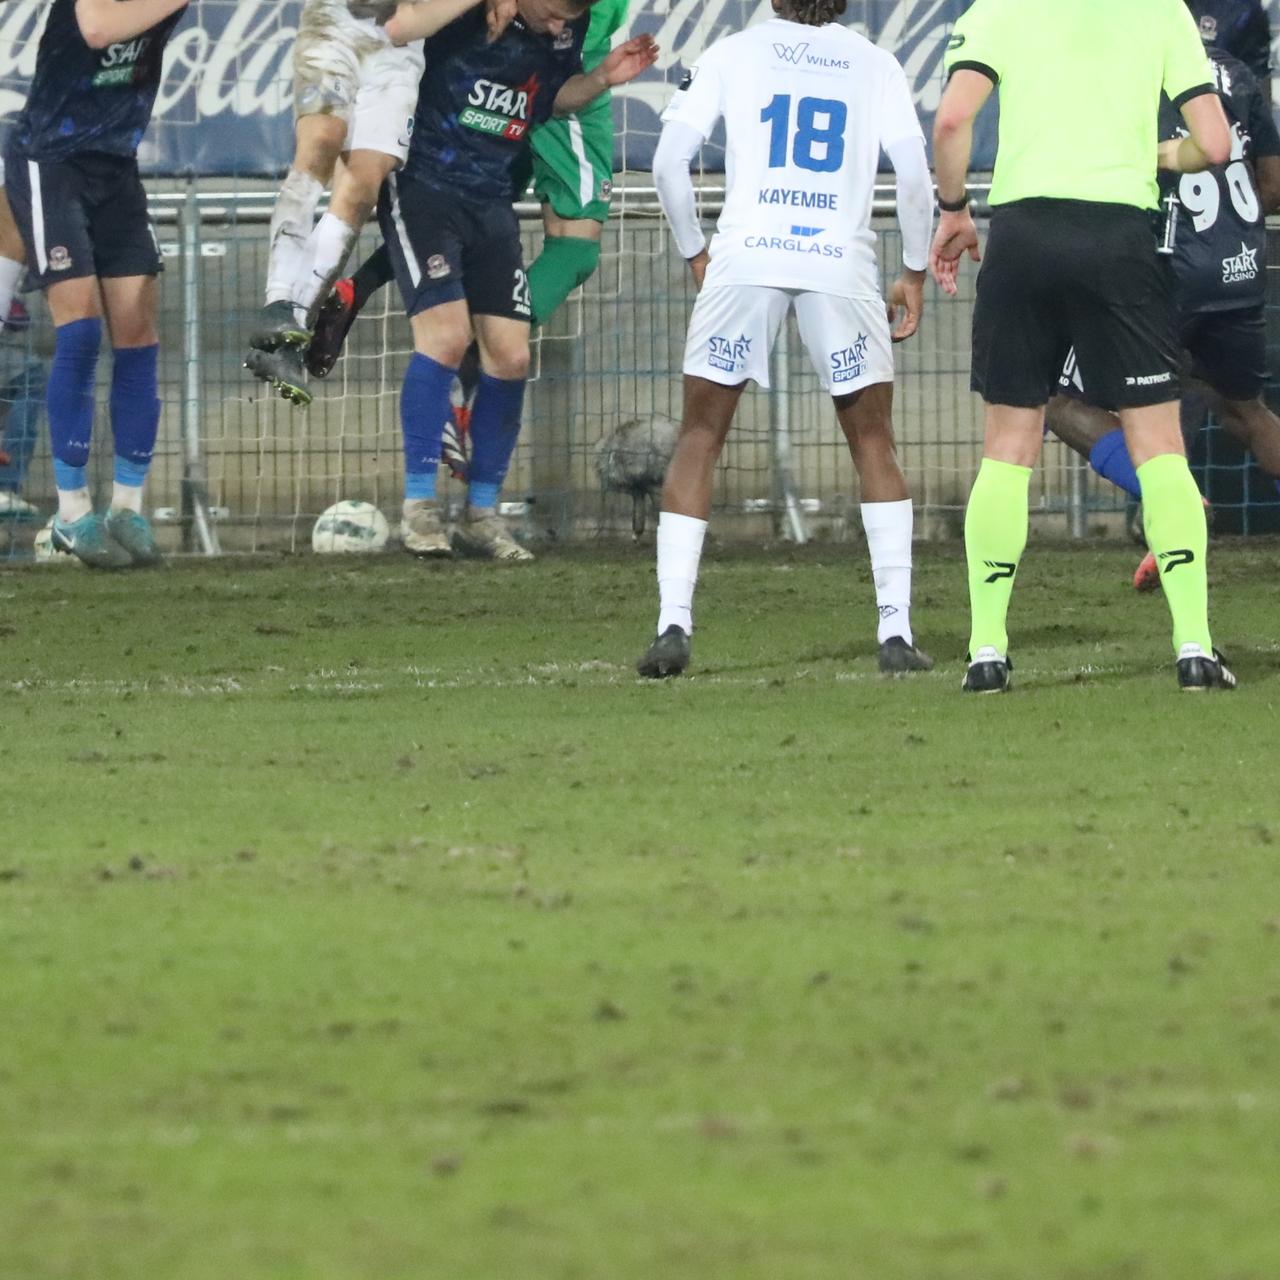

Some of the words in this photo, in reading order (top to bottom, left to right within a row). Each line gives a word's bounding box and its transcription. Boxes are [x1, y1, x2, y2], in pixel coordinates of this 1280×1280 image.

[806, 55, 850, 70] WILMS
[468, 79, 528, 119] STAR
[462, 110, 508, 132] SPORT
[509, 124, 525, 136] TV
[760, 94, 848, 173] 18
[758, 188, 839, 211] KAYEMBE
[1179, 161, 1260, 233] 90
[744, 236, 844, 259] CARGLASS
[1222, 255, 1256, 274] STAR
[1222, 271, 1256, 284] CASINO
[709, 336, 746, 361] STAR
[831, 343, 865, 369] STAR
[834, 367, 858, 382] SPORT
[1137, 371, 1171, 385] PATRICK
